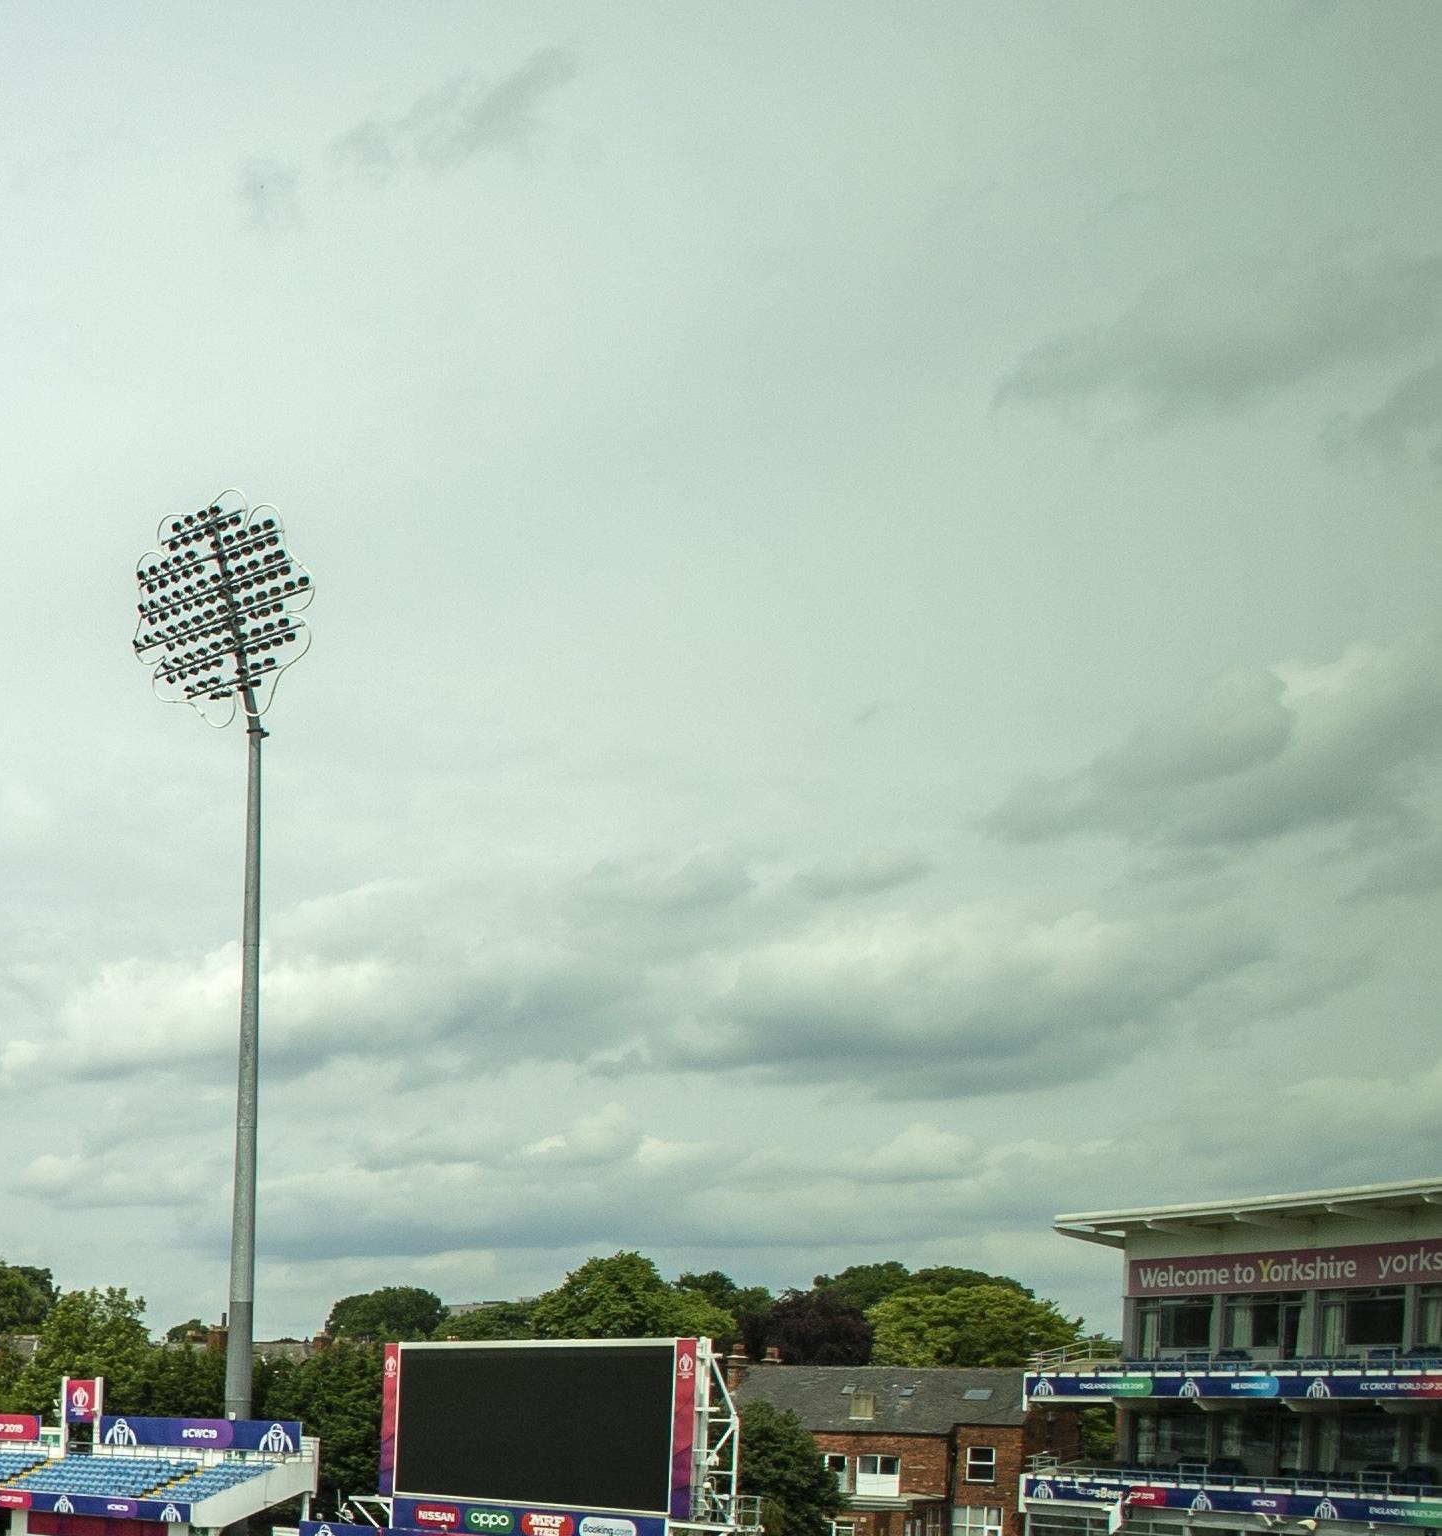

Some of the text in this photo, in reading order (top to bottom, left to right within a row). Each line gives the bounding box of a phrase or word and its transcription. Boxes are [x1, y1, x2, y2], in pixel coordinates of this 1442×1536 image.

[1140, 1256, 1356, 1288] Welcome to Yorkshire
[5, 1424, 24, 1433] 2019
[182, 1428, 217, 1438] #CWC19
[418, 1510, 455, 1522] NISSAN
[471, 1512, 509, 1528] oppo
[529, 1513, 565, 1528] MRF
[582, 1523, 633, 1536] Booking.com
